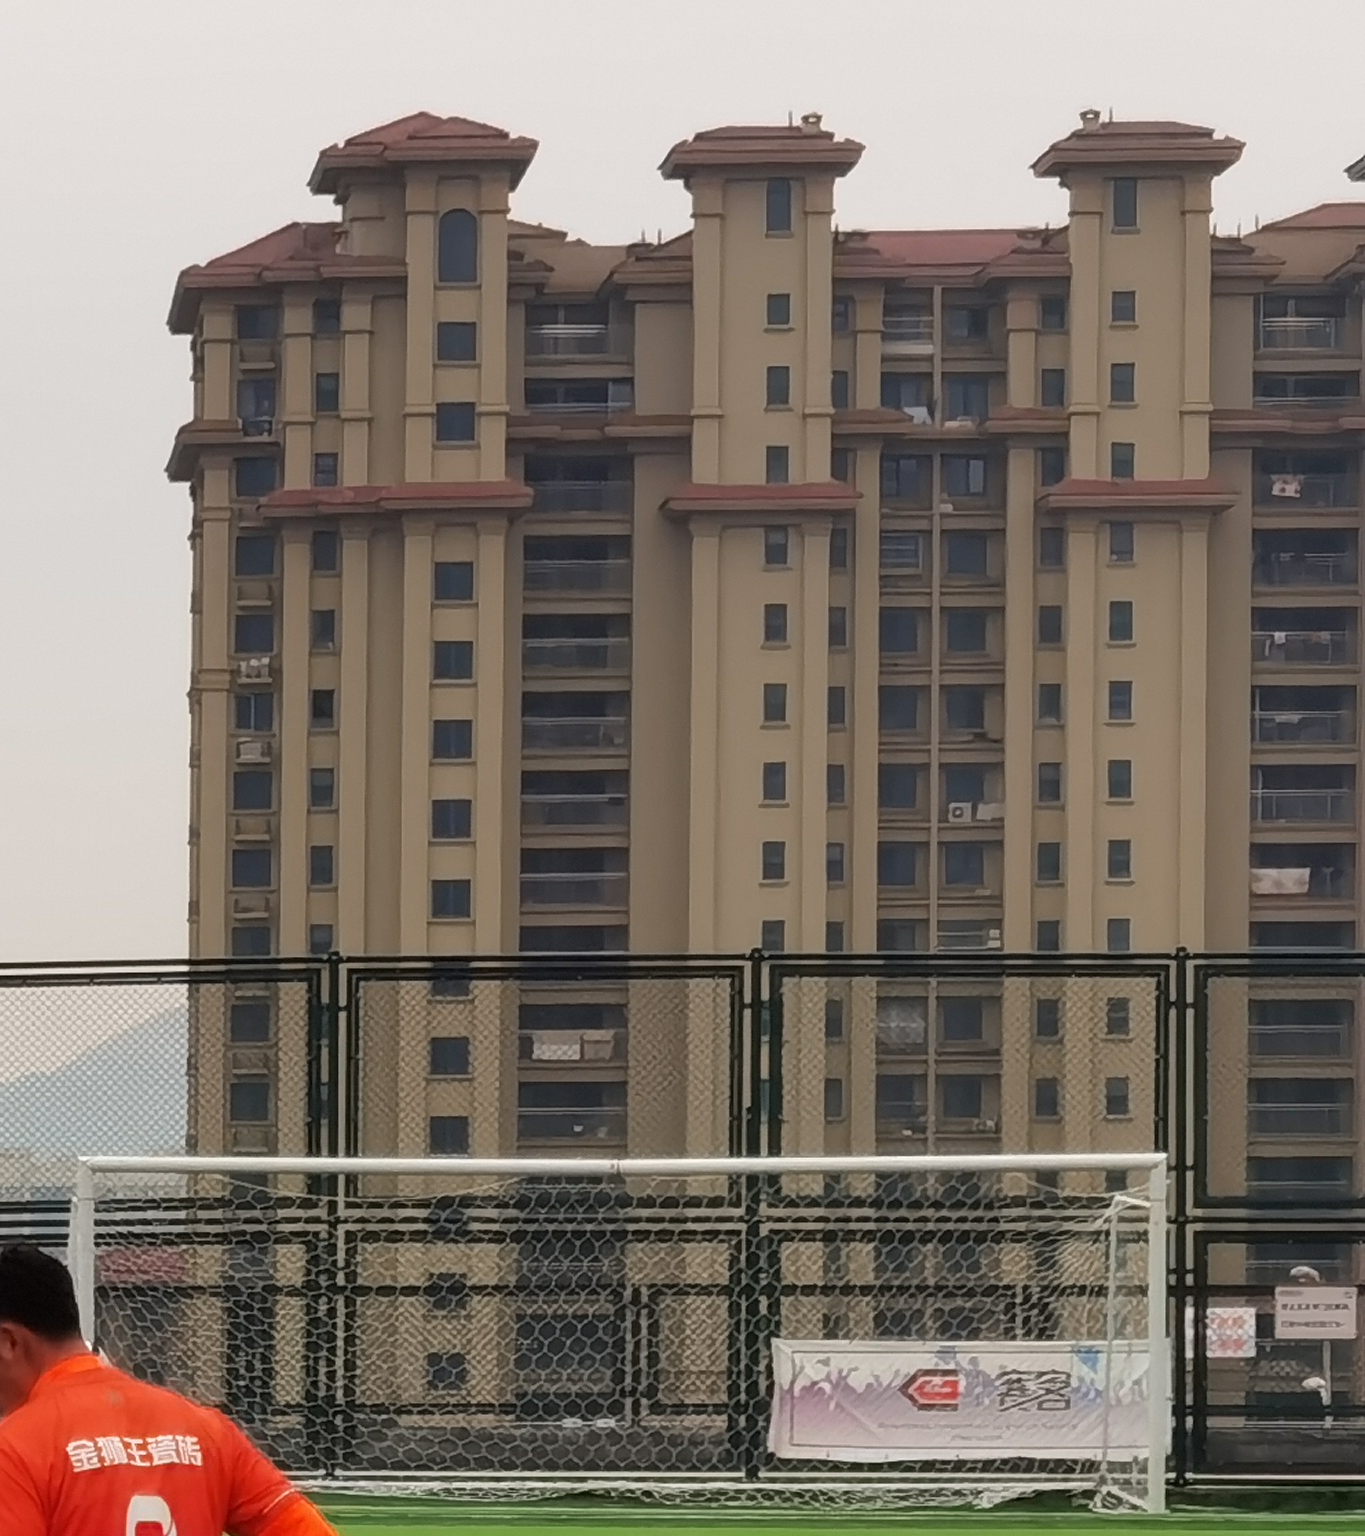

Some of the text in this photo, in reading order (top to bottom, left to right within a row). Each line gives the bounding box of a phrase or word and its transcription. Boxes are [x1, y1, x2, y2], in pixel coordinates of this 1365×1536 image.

[66, 1434, 203, 1473] 金狮王瓷砖
